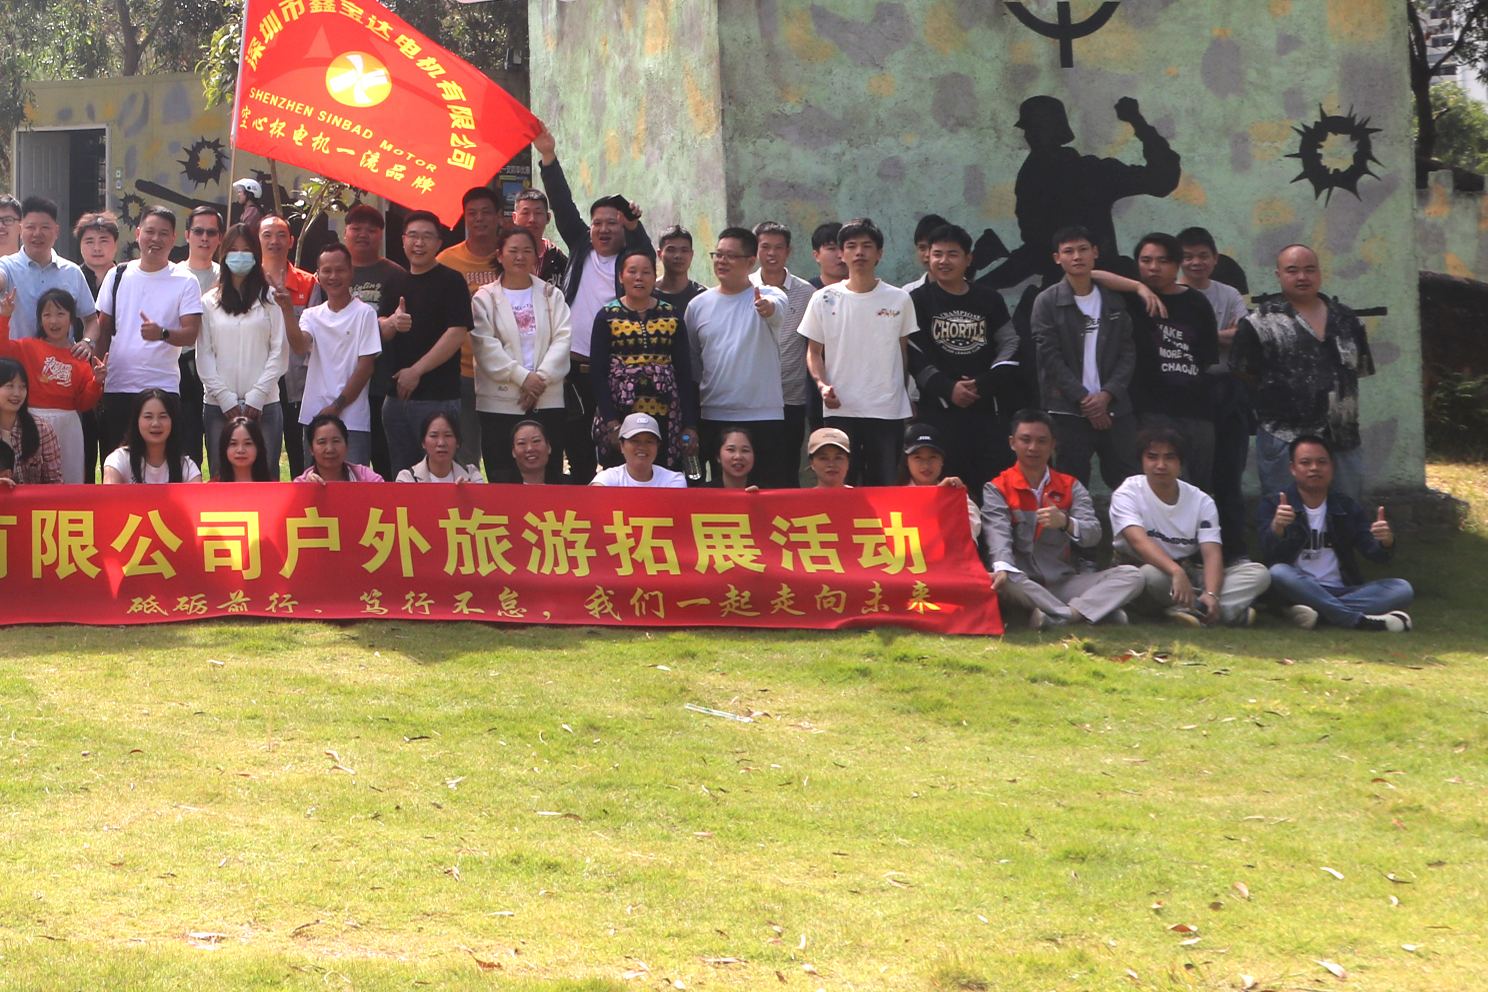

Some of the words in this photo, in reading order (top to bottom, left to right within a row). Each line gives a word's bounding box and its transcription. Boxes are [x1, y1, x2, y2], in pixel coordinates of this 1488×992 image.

[239, 106, 436, 195] 空心杯电机一流品牌
[248, 87, 314, 118] SHENZHEN
[317, 110, 374, 140] SINBAD
[379, 139, 438, 174] MOTOR
[932, 319, 986, 343] CHORTLE
[1159, 347, 1183, 359] MORE
